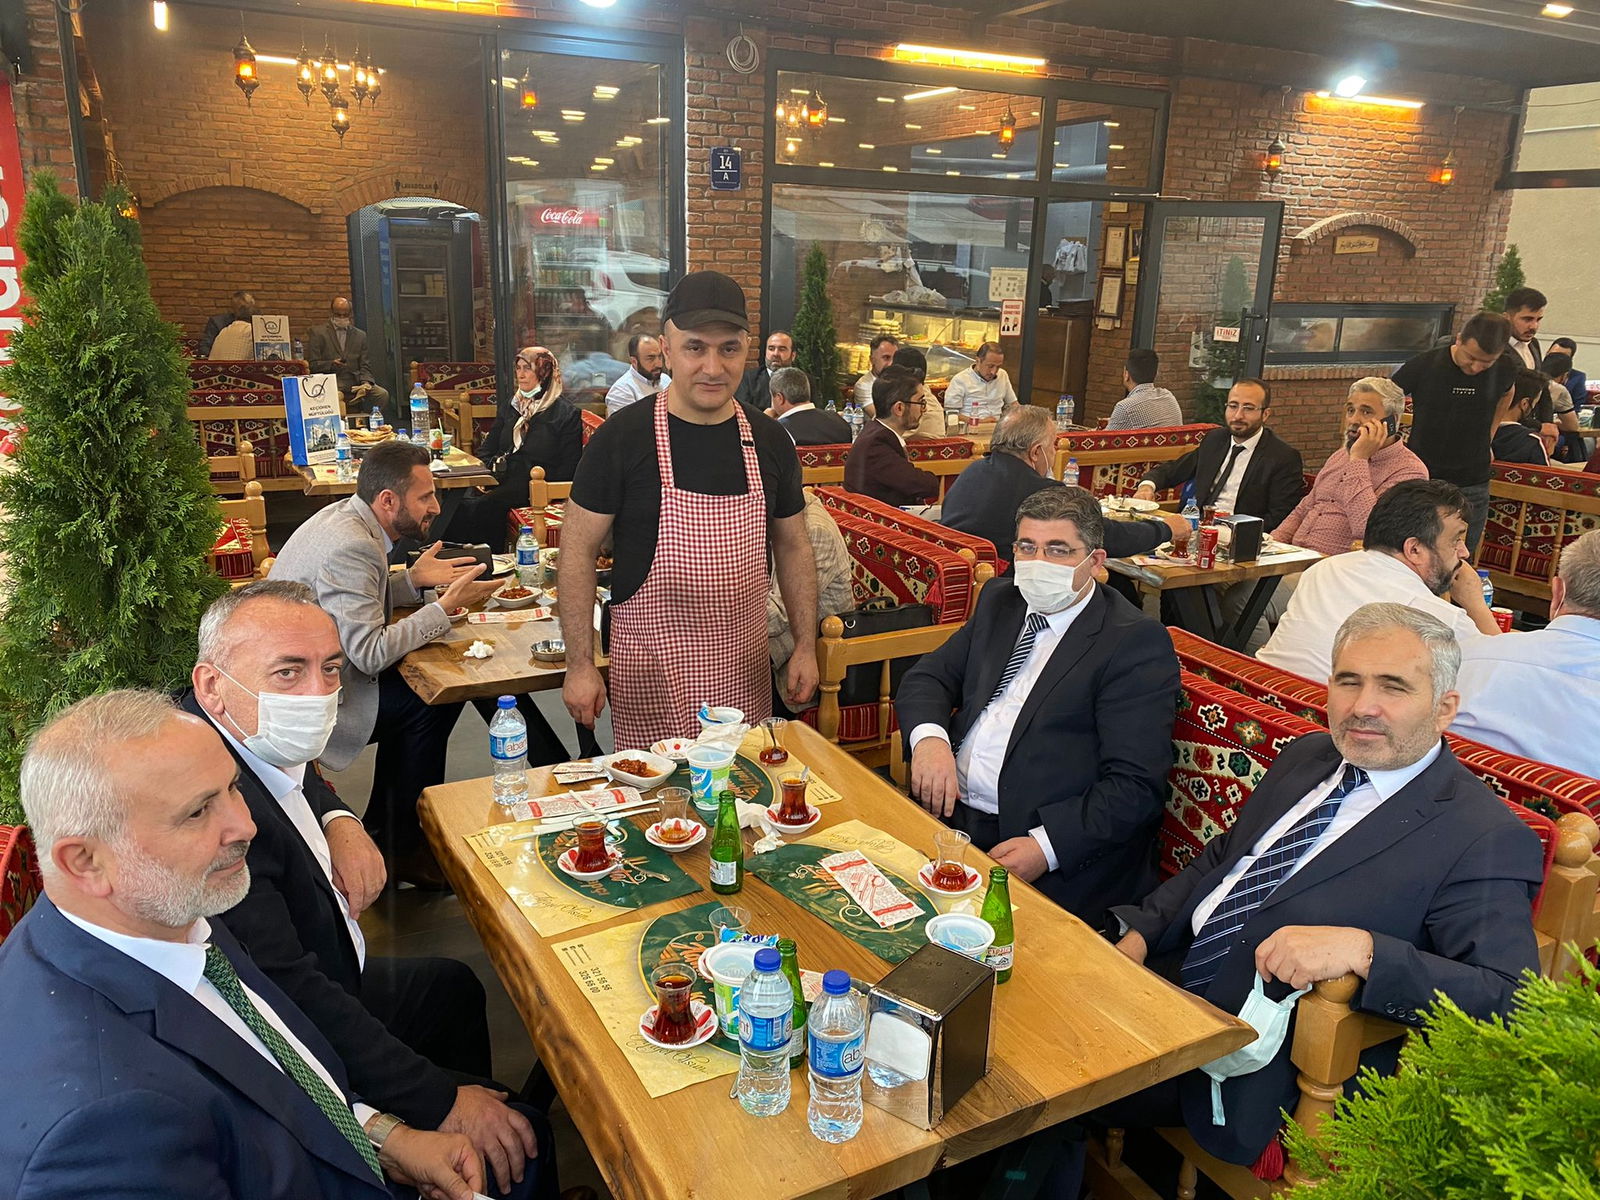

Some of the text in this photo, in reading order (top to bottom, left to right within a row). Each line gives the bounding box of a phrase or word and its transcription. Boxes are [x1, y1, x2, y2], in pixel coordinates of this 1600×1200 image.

[720, 155, 732, 169] 14
[540, 208, 584, 224] Coca-Cola
[506, 739, 527, 752] aban
